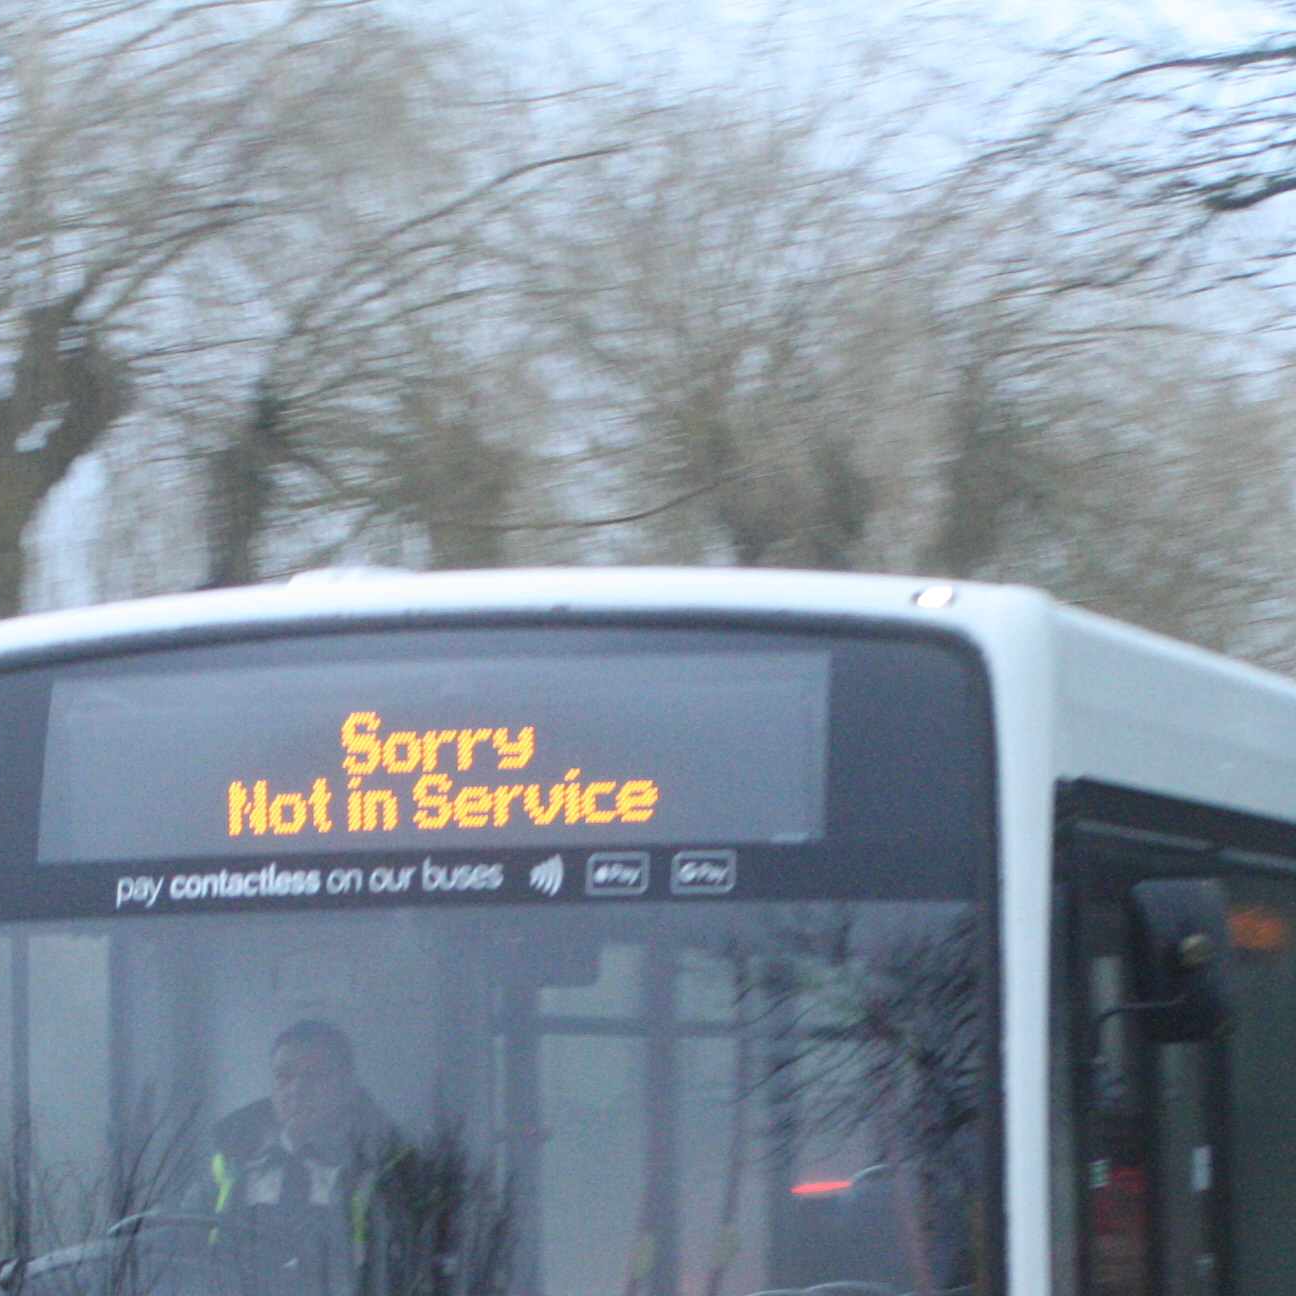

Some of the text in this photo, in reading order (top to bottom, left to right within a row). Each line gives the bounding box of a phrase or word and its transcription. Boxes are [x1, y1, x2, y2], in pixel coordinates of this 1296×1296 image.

[341, 711, 535, 776] Sorry
[228, 768, 659, 836] Not in Service
[116, 856, 504, 909] pay contactless on our buses
